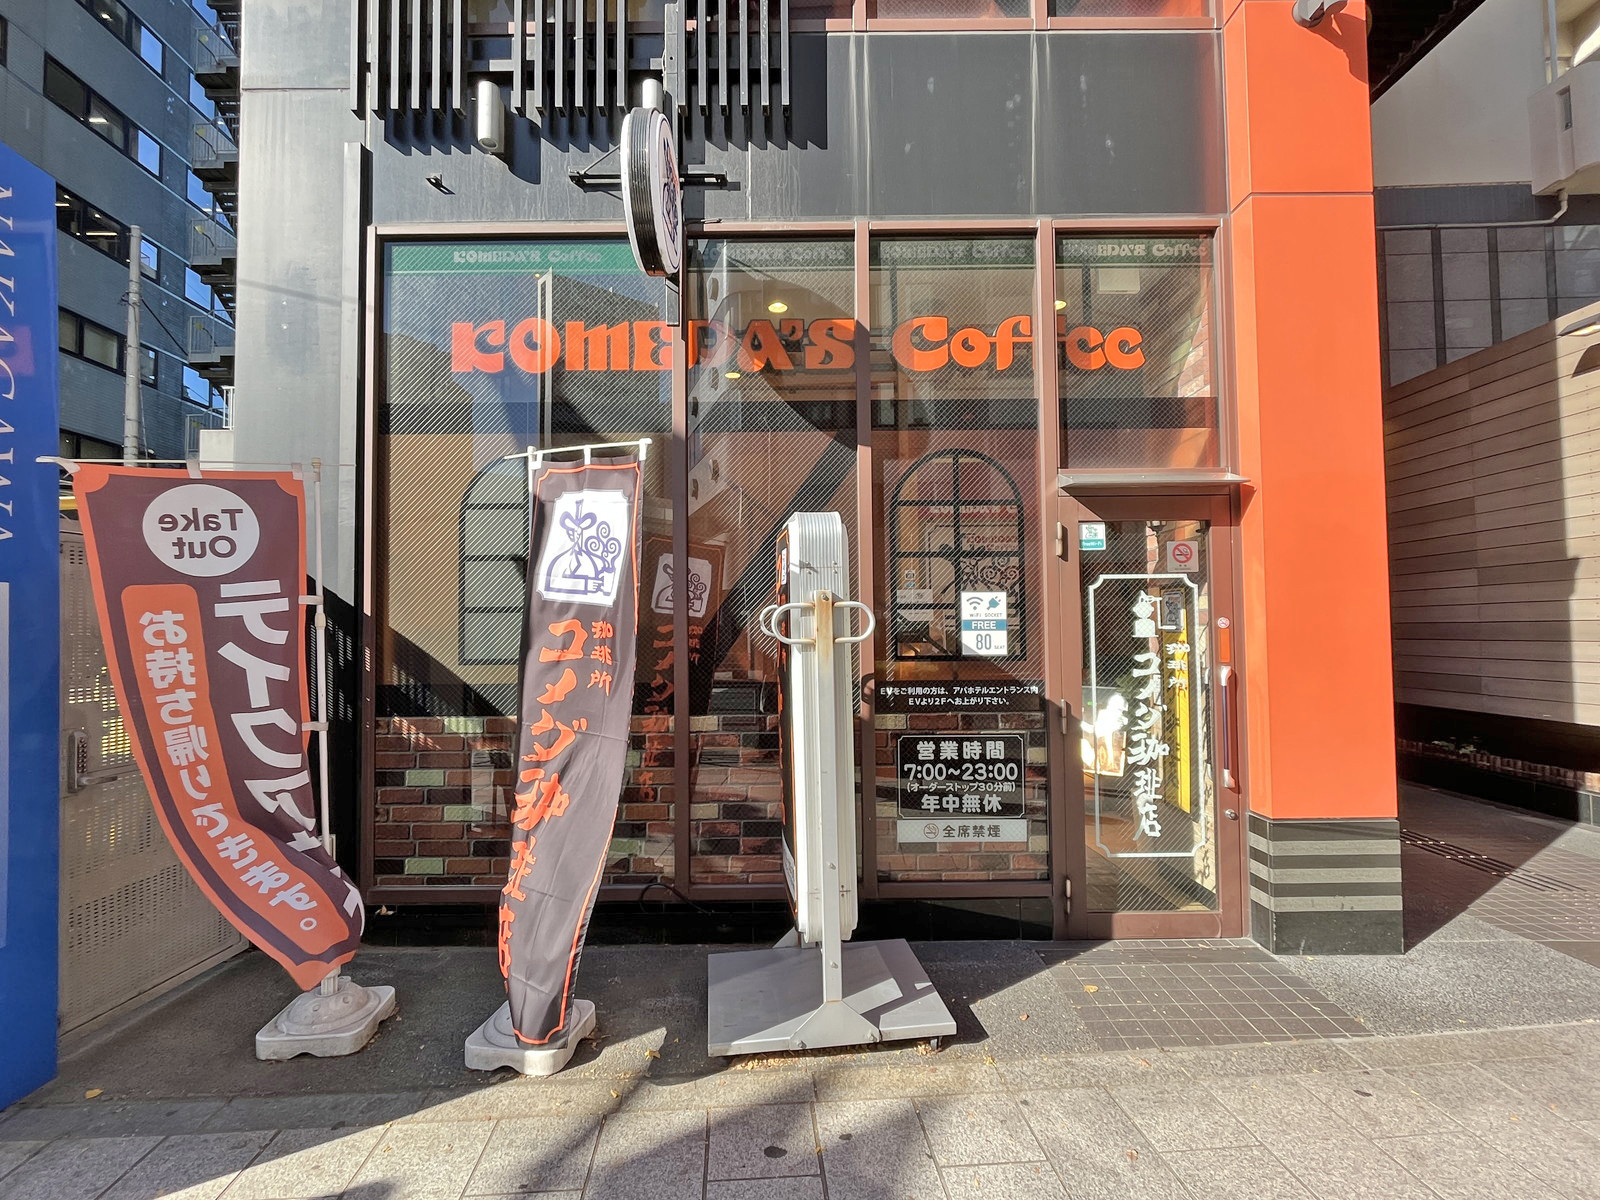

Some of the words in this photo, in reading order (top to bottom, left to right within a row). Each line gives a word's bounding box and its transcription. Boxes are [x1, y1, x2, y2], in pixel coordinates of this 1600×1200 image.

[971, 620, 997, 630] FREE
[975, 633, 992, 650] 80
[916, 740, 1005, 760] 営業時間
[921, 793, 1002, 813] 年中無休
[942, 824, 1001, 838] 全席禁煙
